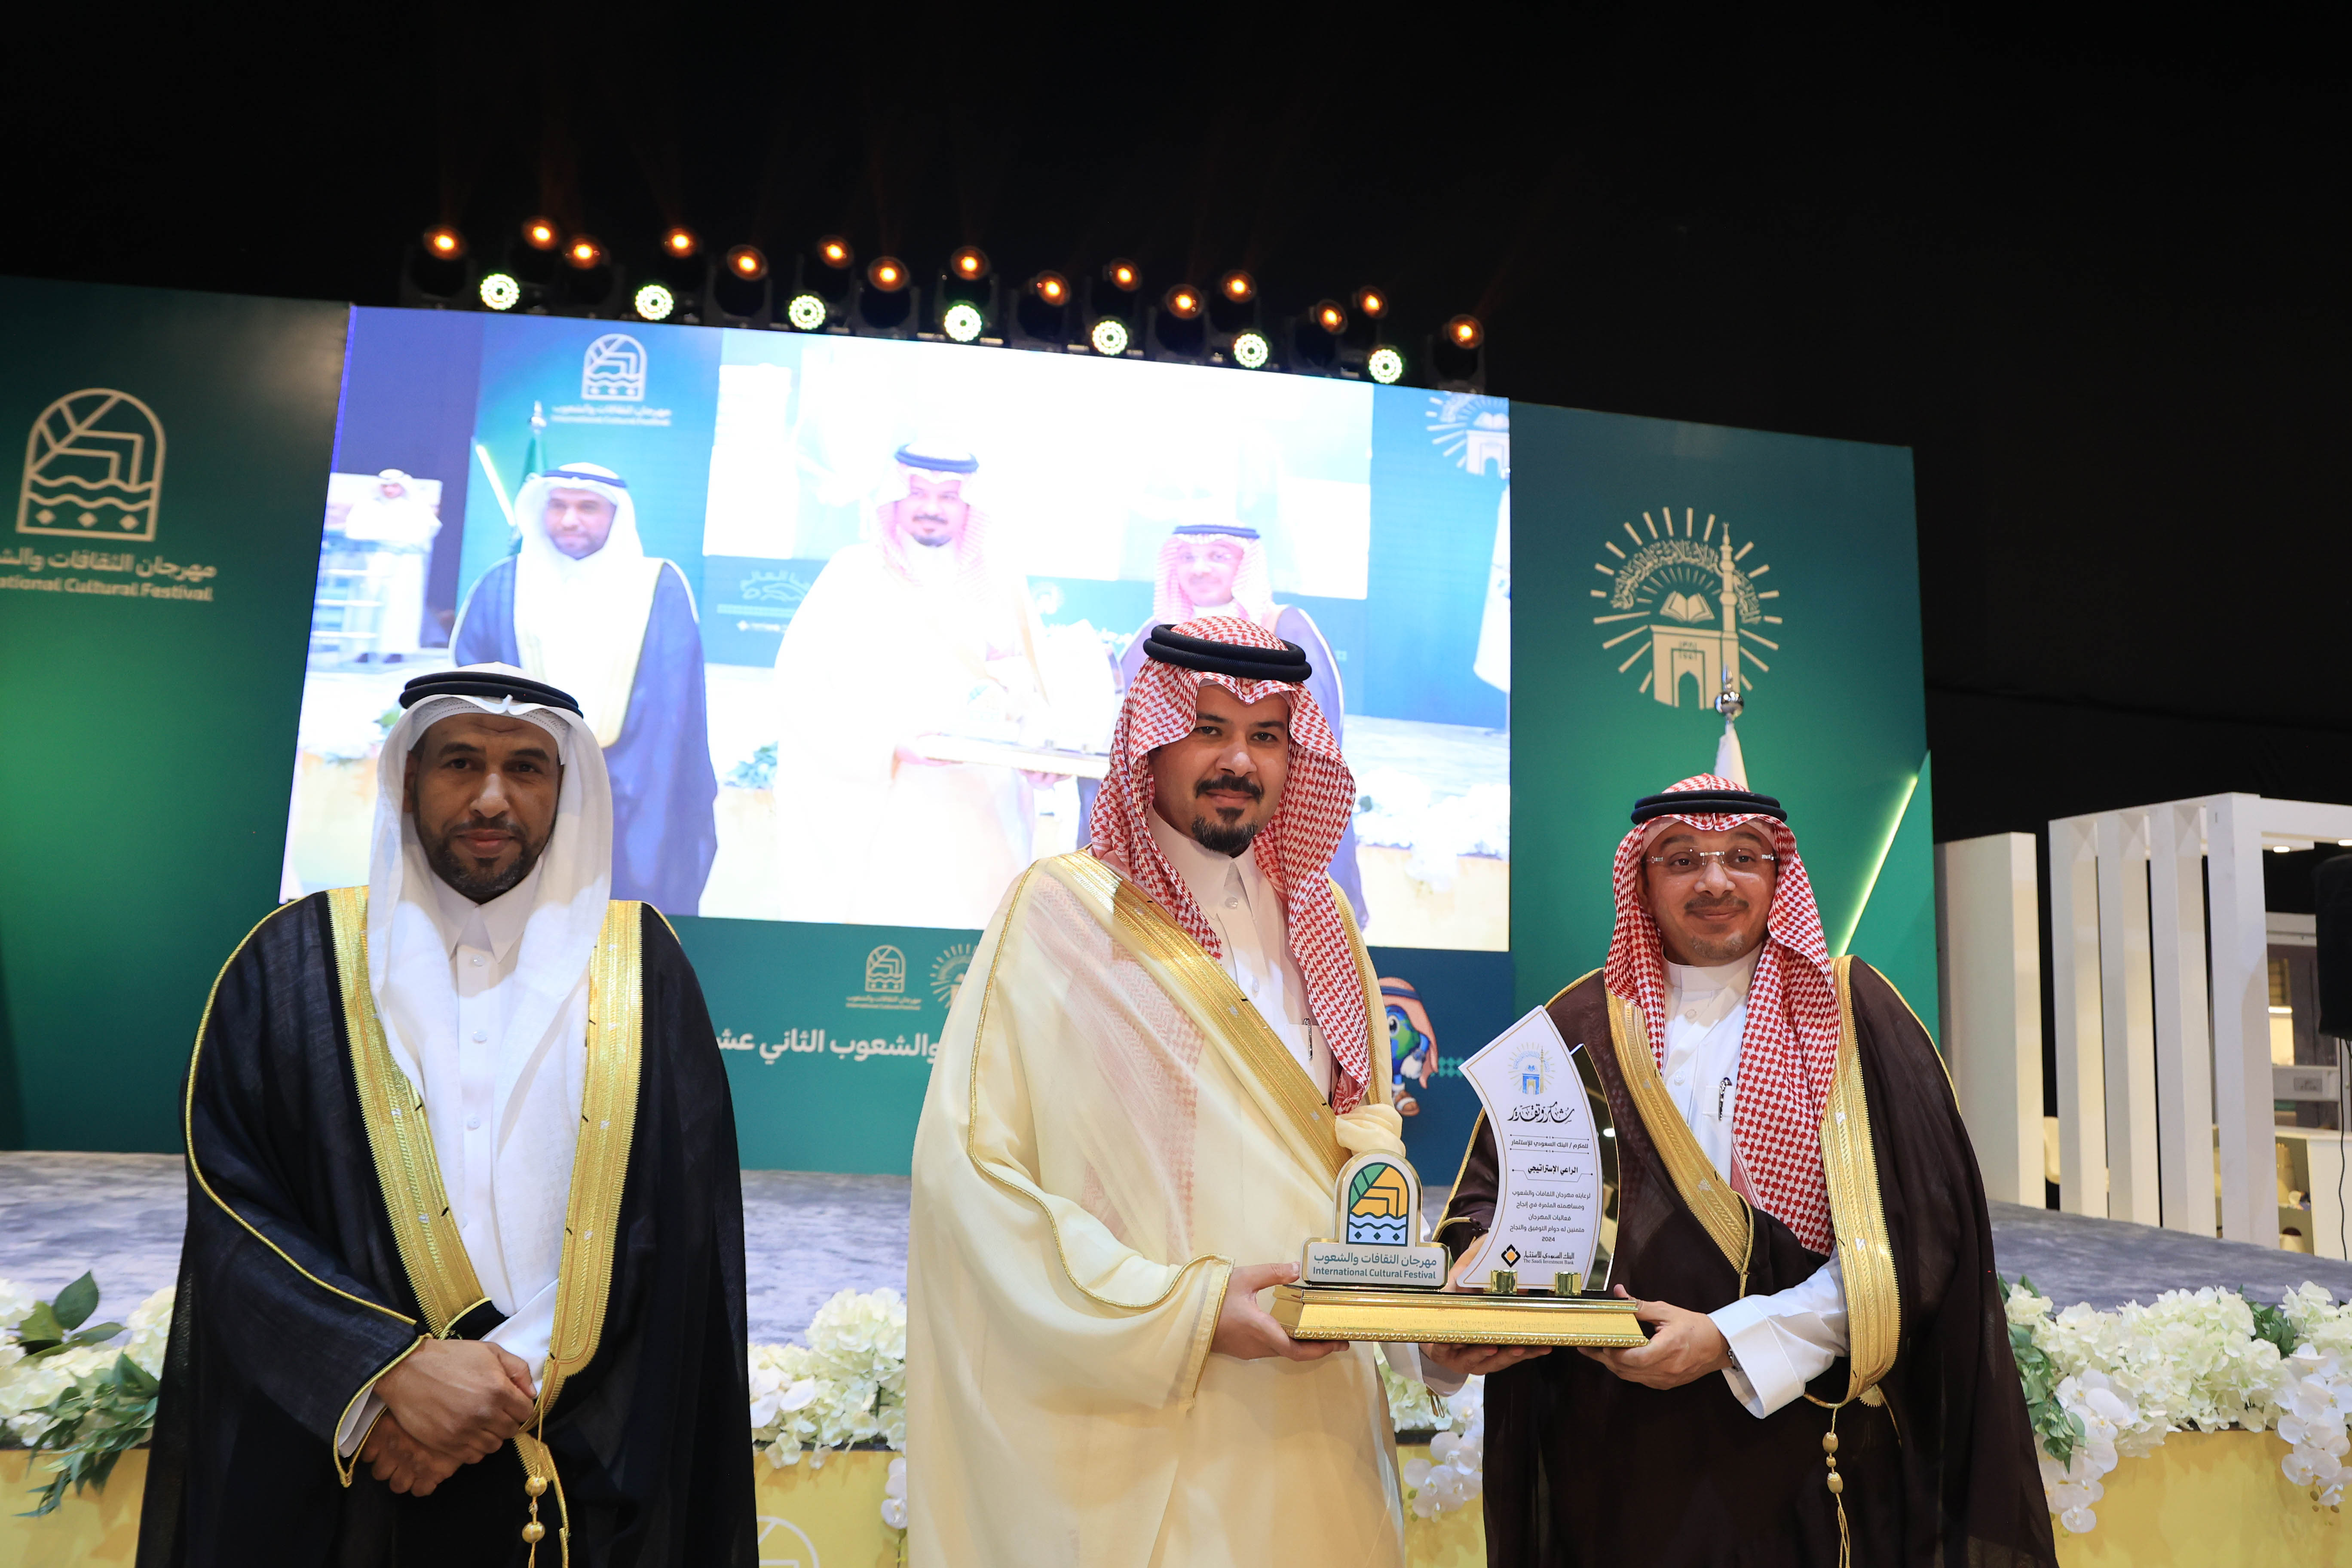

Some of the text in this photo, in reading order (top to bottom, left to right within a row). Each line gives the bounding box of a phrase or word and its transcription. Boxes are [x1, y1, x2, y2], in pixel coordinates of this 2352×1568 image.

[0, 547, 217, 582] مهرجان الثقافات والش
[64, 578, 139, 597] Cultural
[141, 582, 214, 601] Festival
[715, 1027, 939, 1065] والشعوب الثاني عش
[1528, 1164, 1578, 1176] الراعي الإستراتيجي
[1314, 1252, 1437, 1268] مهرجان الثقافات والشعوب
[1313, 1266, 1436, 1279] International Cultural Festival
